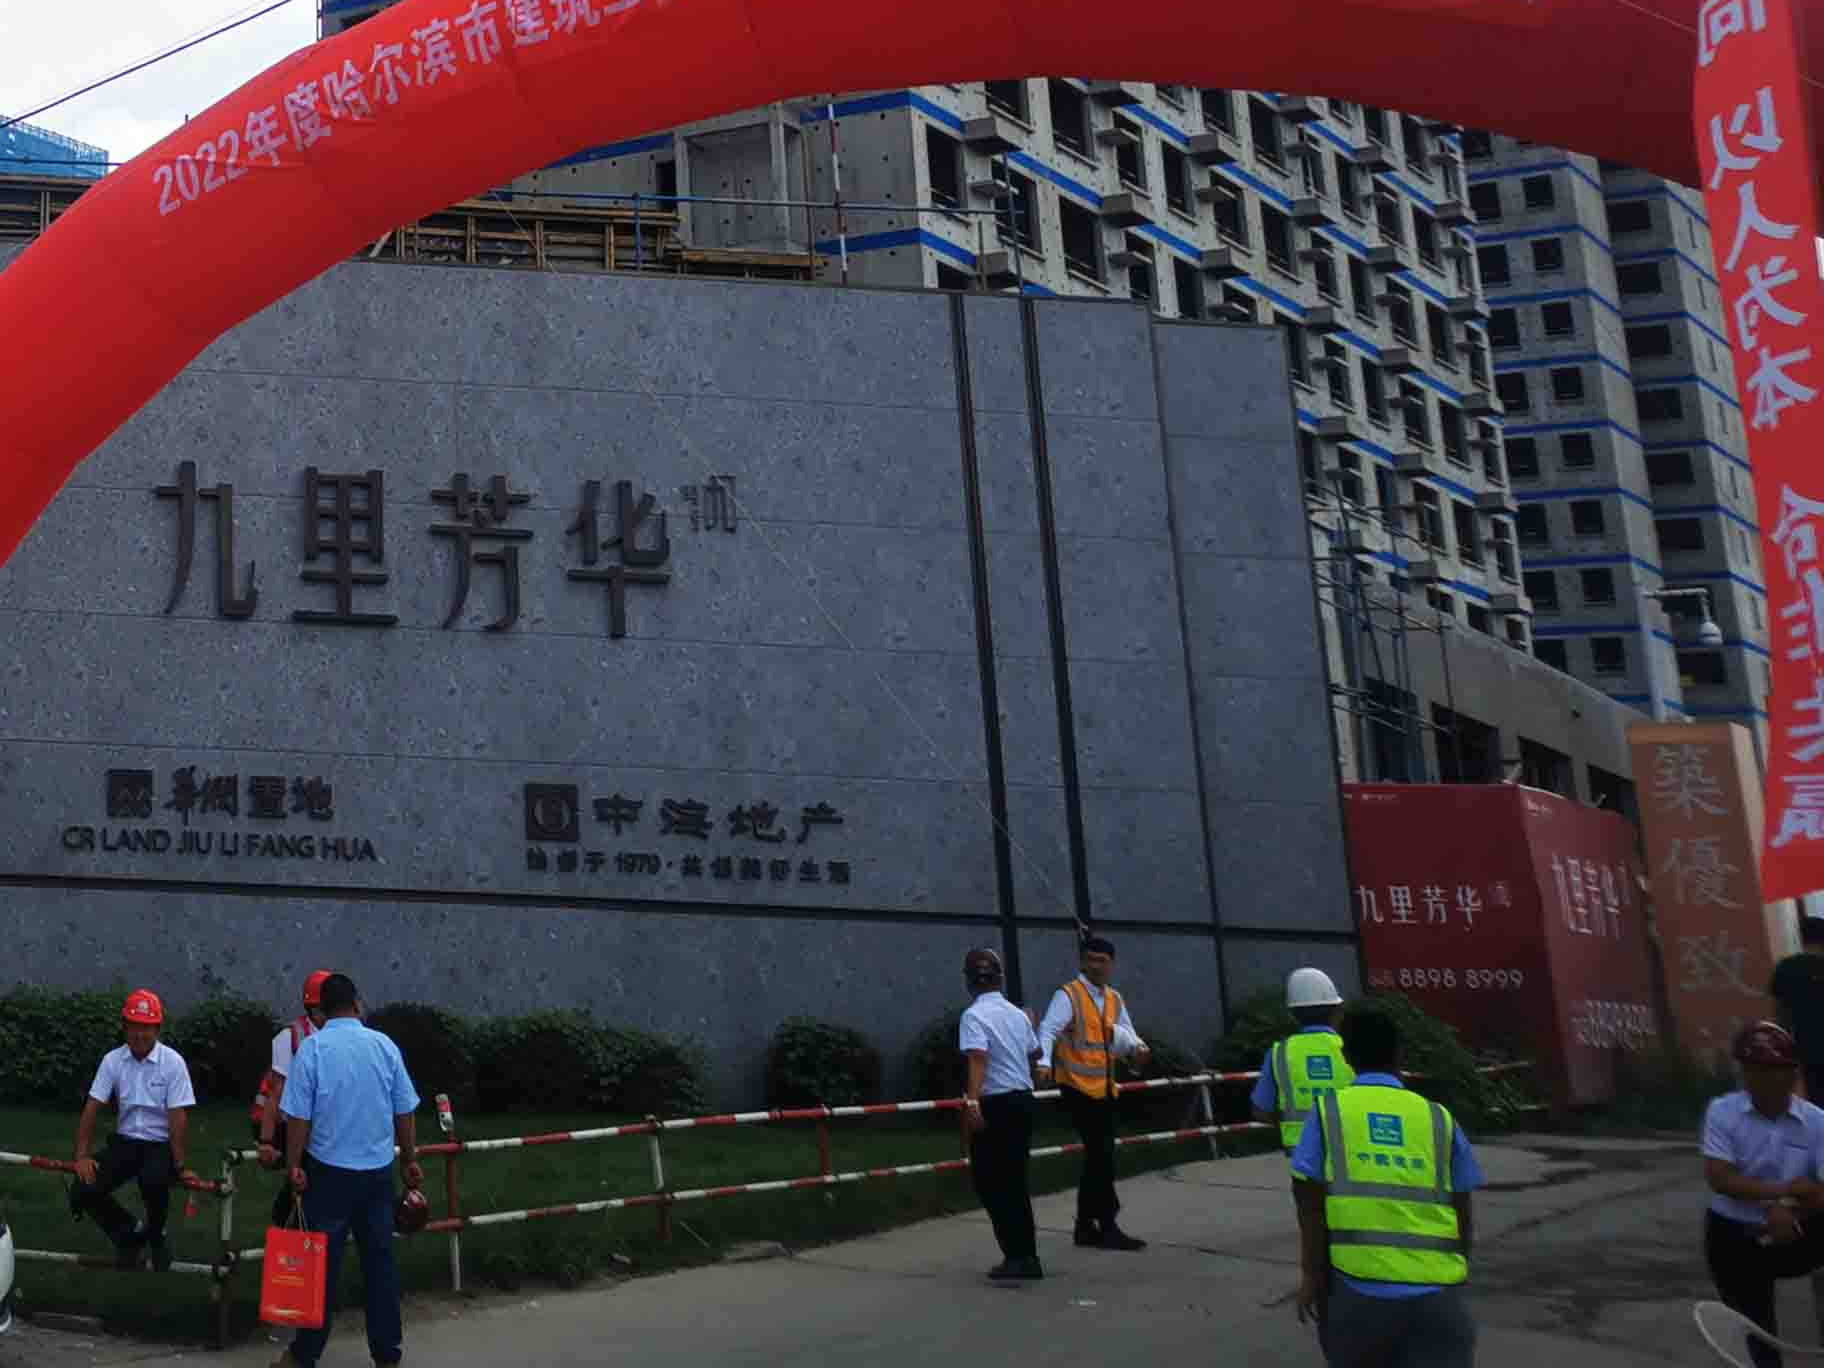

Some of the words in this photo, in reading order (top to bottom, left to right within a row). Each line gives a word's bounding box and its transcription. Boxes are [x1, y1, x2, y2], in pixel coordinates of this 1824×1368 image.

[156, 460, 671, 639] 九里芳华
[593, 793, 844, 845] 中海地产
[62, 827, 95, 852] CR
[101, 829, 171, 854] LAND
[176, 829, 213, 856] JIU
[219, 831, 239, 857] LI
[247, 833, 315, 859] FANG
[320, 837, 378, 863] HUA
[1356, 884, 1482, 929] 九里芳华
[1399, 967, 1457, 988] 8898
[1464, 968, 1524, 989] 8999
